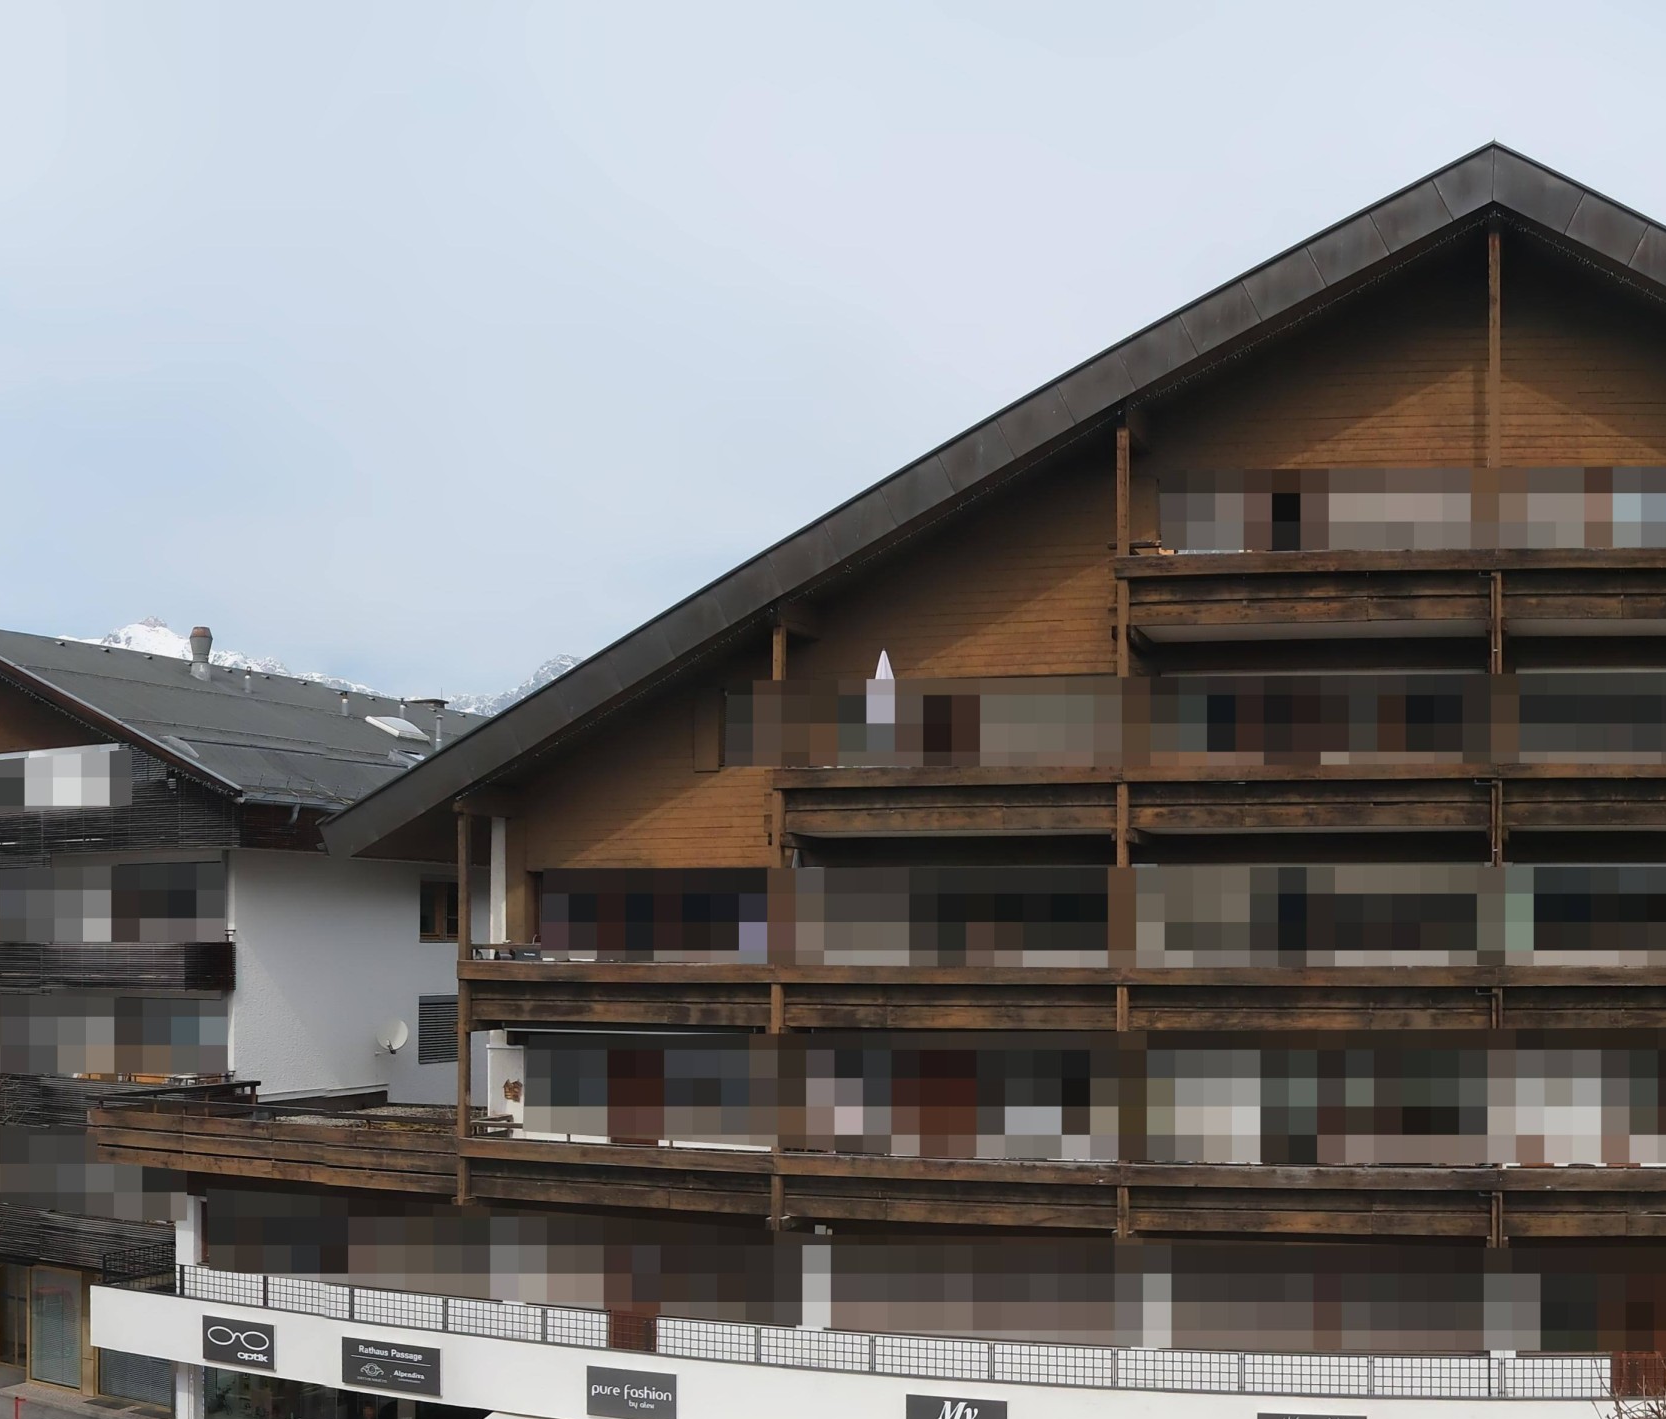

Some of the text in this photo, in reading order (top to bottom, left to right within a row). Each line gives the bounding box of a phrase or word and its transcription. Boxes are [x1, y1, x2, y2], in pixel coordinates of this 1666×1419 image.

[237, 1352, 269, 1363] optik
[358, 1345, 423, 1361] Rathaus Passage
[591, 1384, 672, 1401] pure fashion
[629, 1400, 638, 1409] by
